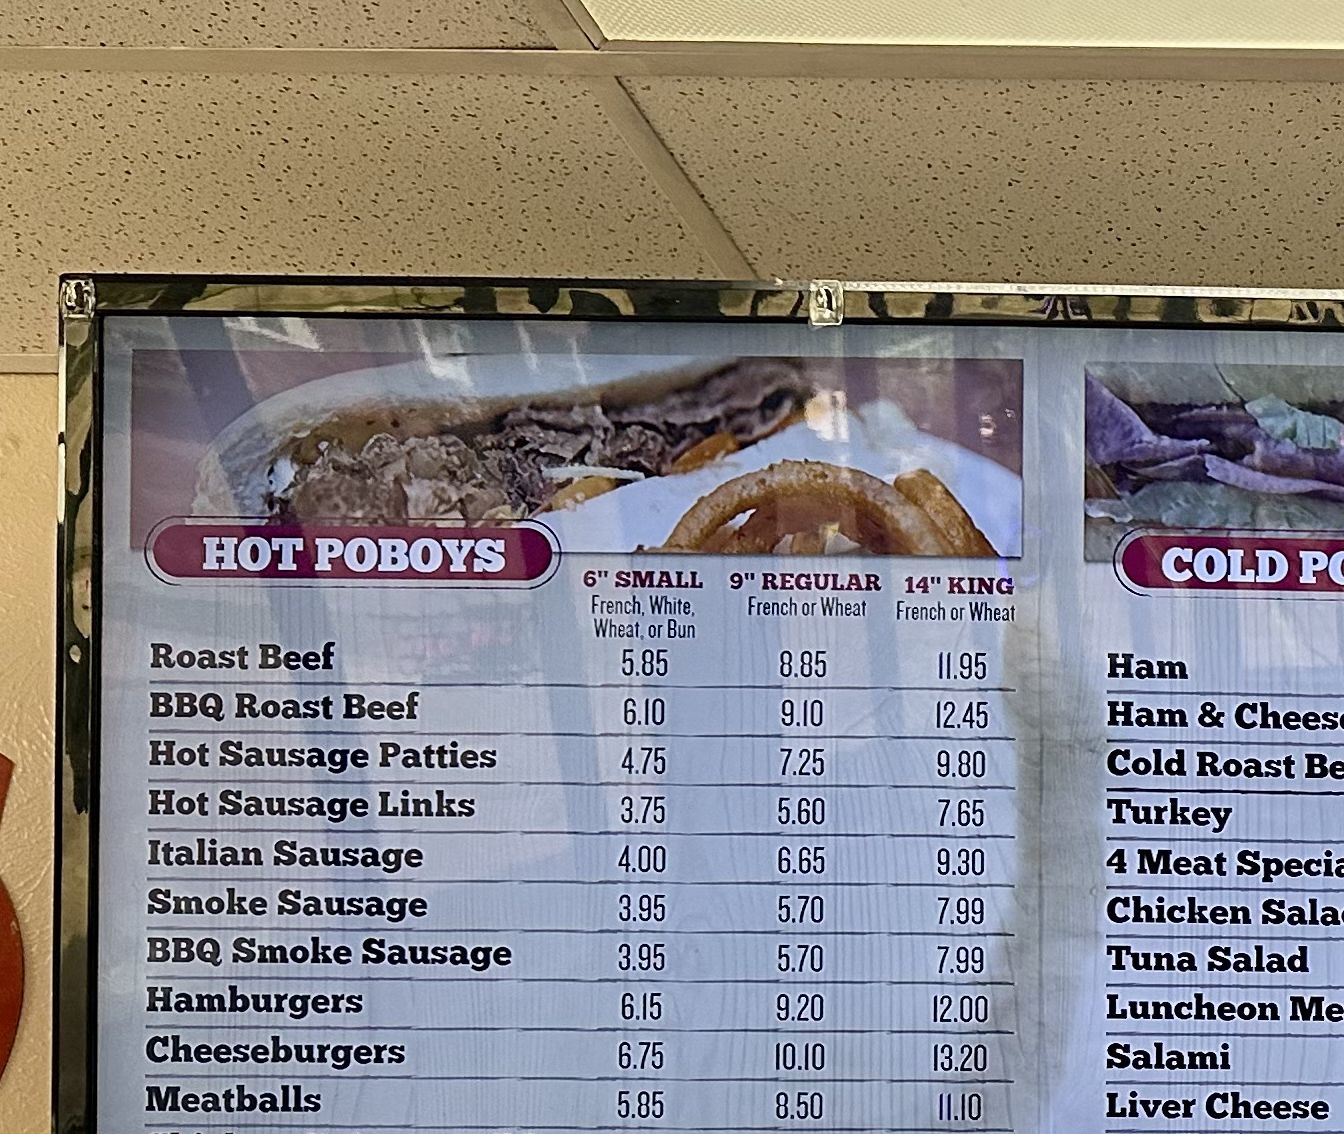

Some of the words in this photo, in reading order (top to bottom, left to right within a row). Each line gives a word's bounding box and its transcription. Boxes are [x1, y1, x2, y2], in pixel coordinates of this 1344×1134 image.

[202, 536, 304, 572] HOT
[314, 537, 506, 573] POBOYS
[1161, 546, 1289, 583] COLD
[583, 570, 609, 588] 6"
[614, 570, 704, 589] SMALL
[729, 572, 755, 590] 9"
[761, 572, 882, 592] REGULAR
[904, 576, 941, 594] 14"
[947, 576, 1015, 595] KING
[591, 594, 645, 617] French,
[649, 595, 695, 617] White,
[748, 595, 798, 616] French
[801, 602, 817, 617] or
[820, 596, 867, 617] Wheat
[593, 618, 645, 642] Wheat,
[648, 624, 664, 639] or
[667, 618, 696, 639] Bun
[150, 642, 249, 670] Roast
[258, 641, 336, 671] Beef
[622, 648, 668, 677] 5.85
[779, 650, 827, 678] 8.85
[938, 652, 987, 680] 11.95
[1106, 798, 1233, 834] Turkey
[1106, 848, 1127, 874] 4
[1137, 848, 1227, 877] Meat
[1106, 1091, 1197, 1119] Liver
[1205, 1091, 1330, 1120] Cheese
